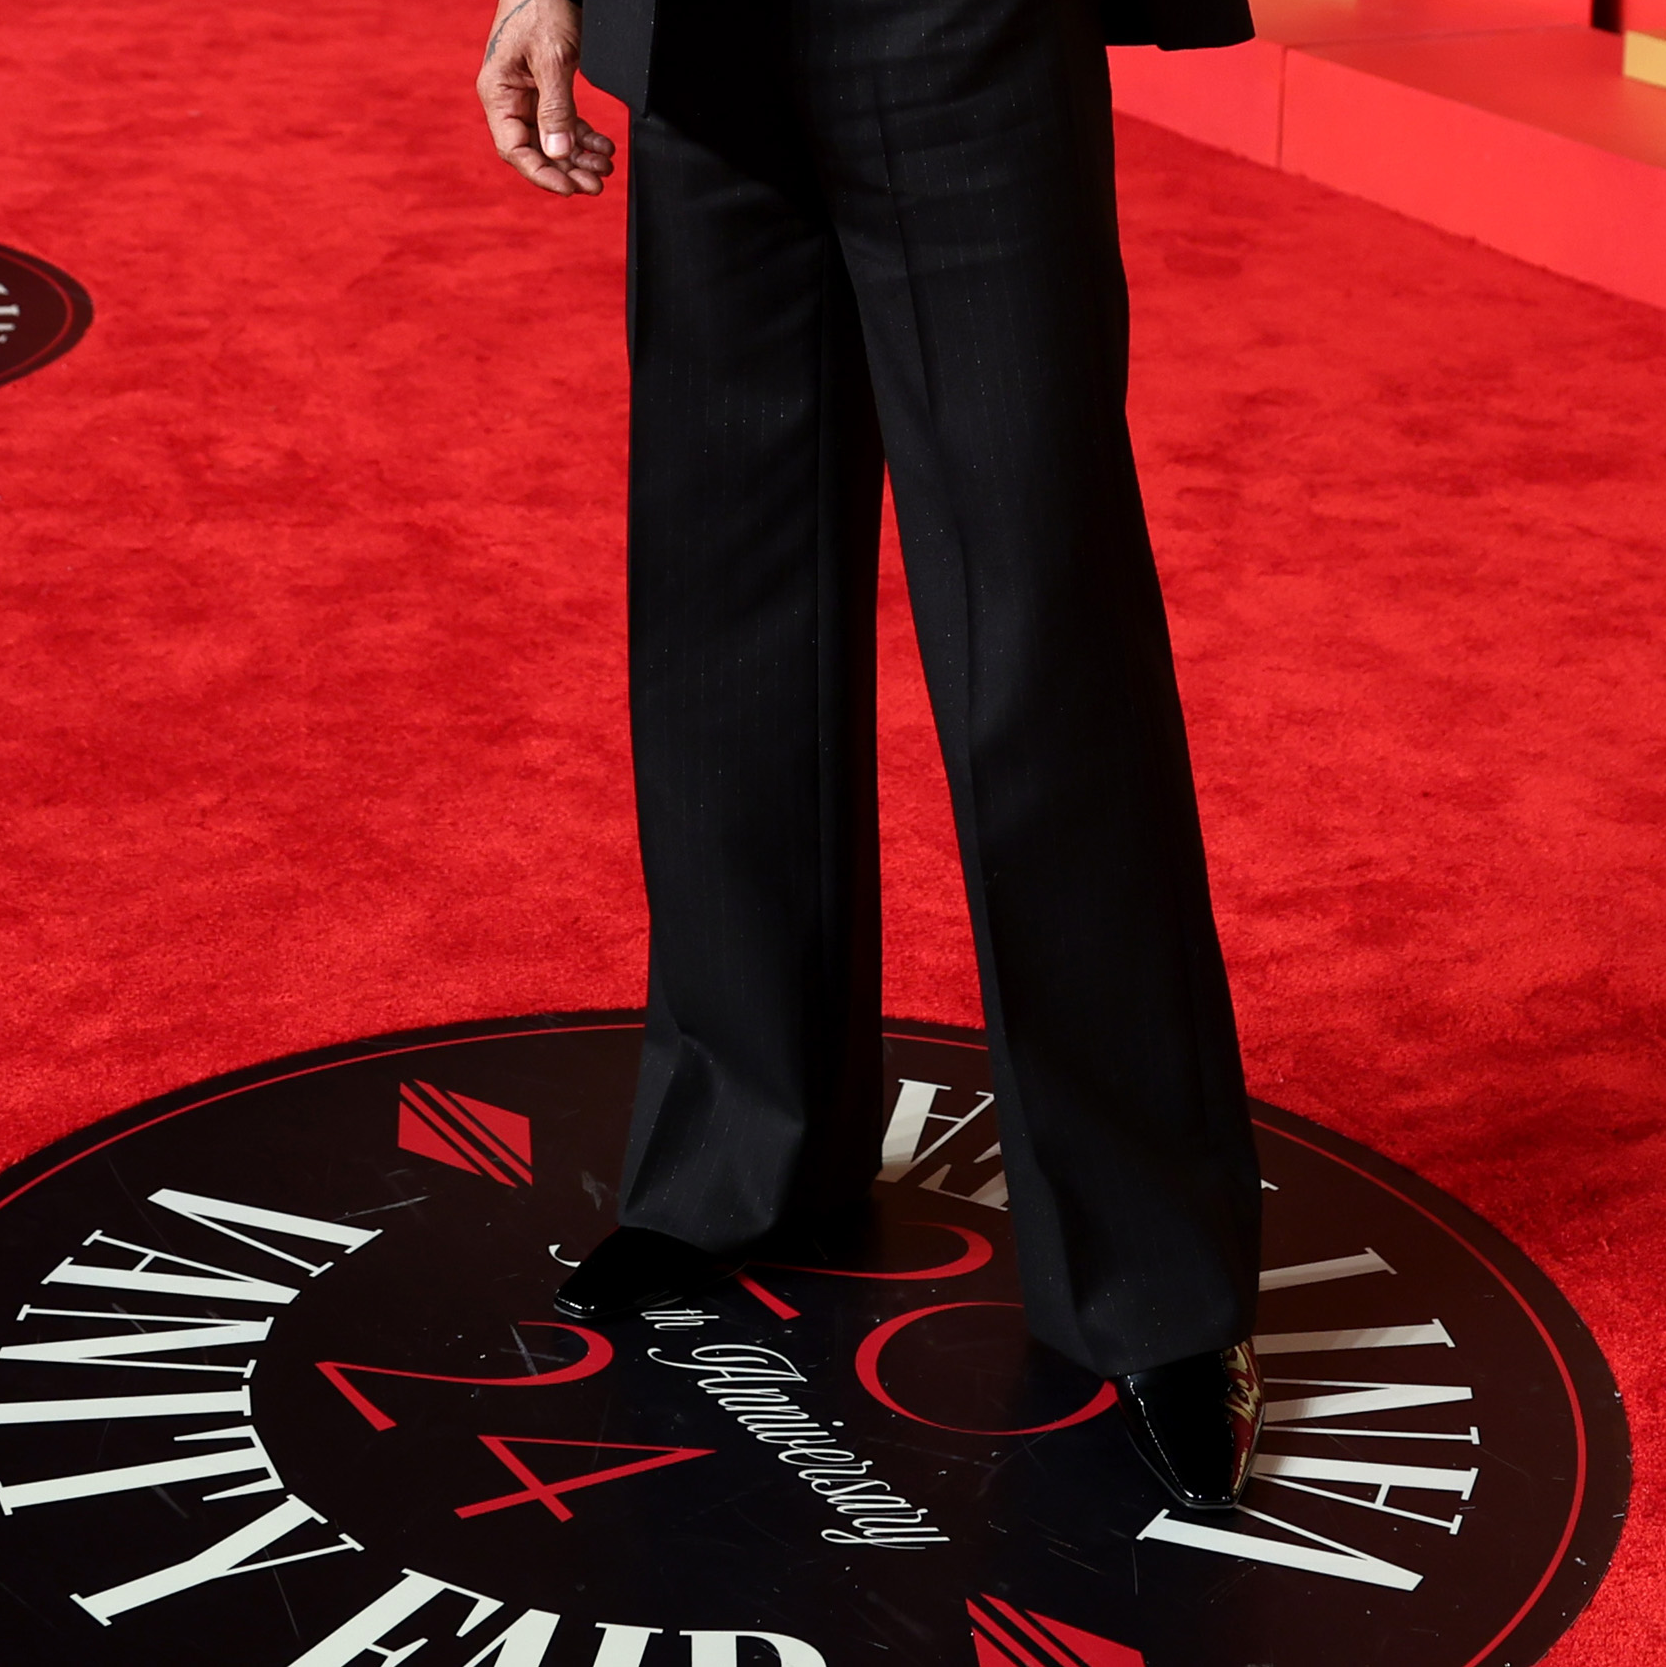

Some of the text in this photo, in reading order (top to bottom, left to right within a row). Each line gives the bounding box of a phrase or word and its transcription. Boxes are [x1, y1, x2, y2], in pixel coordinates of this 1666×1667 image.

[315, 1321, 718, 1523] 24
[647, 1343, 951, 1551] Anniversary
[1135, 1179, 1481, 1592] VANI
